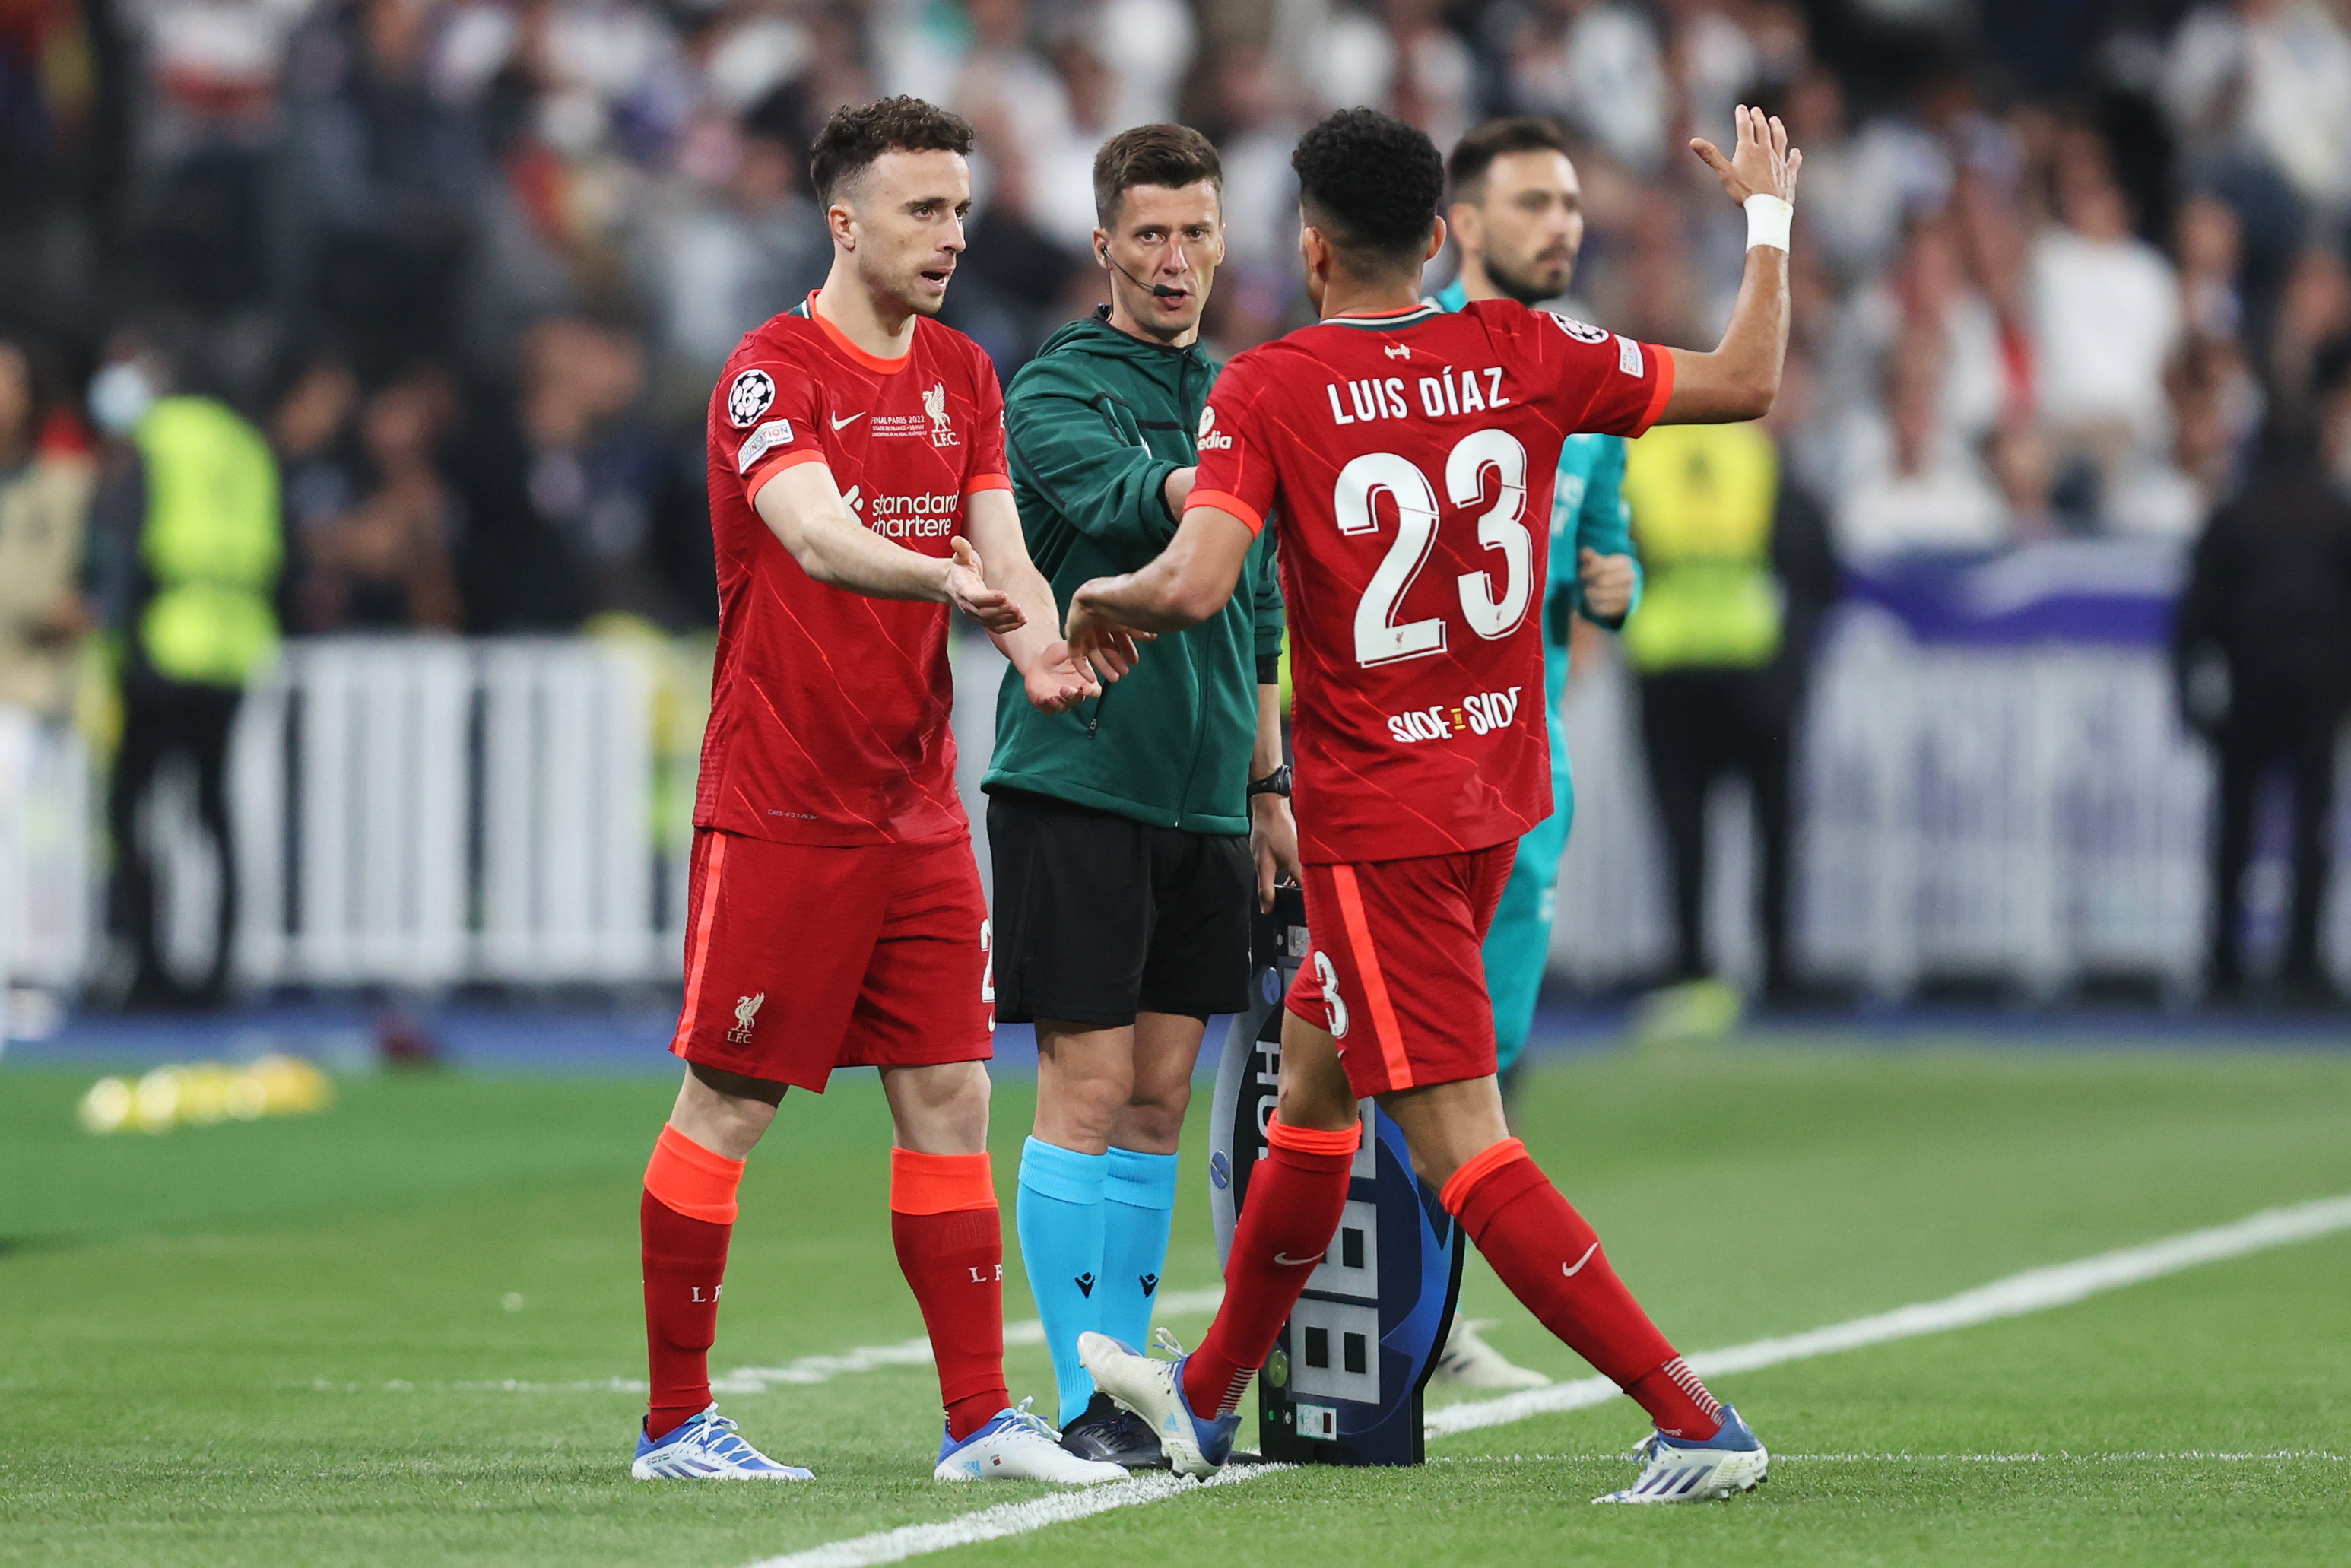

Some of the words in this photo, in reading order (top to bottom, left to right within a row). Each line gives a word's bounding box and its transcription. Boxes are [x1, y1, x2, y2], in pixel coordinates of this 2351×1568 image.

[1327, 377, 1408, 425] LUIS
[1418, 365, 1511, 417] DÍAZ
[871, 416, 888, 424] FINAL
[909, 414, 925, 424] 2022
[1197, 430, 1233, 451] edia
[872, 490, 959, 516] standard
[871, 515, 951, 537] chartere
[1334, 428, 1534, 668] 23
[1387, 705, 1453, 743] SIDE
[980, 919, 995, 1003] 2
[1314, 951, 1349, 1039] 3
